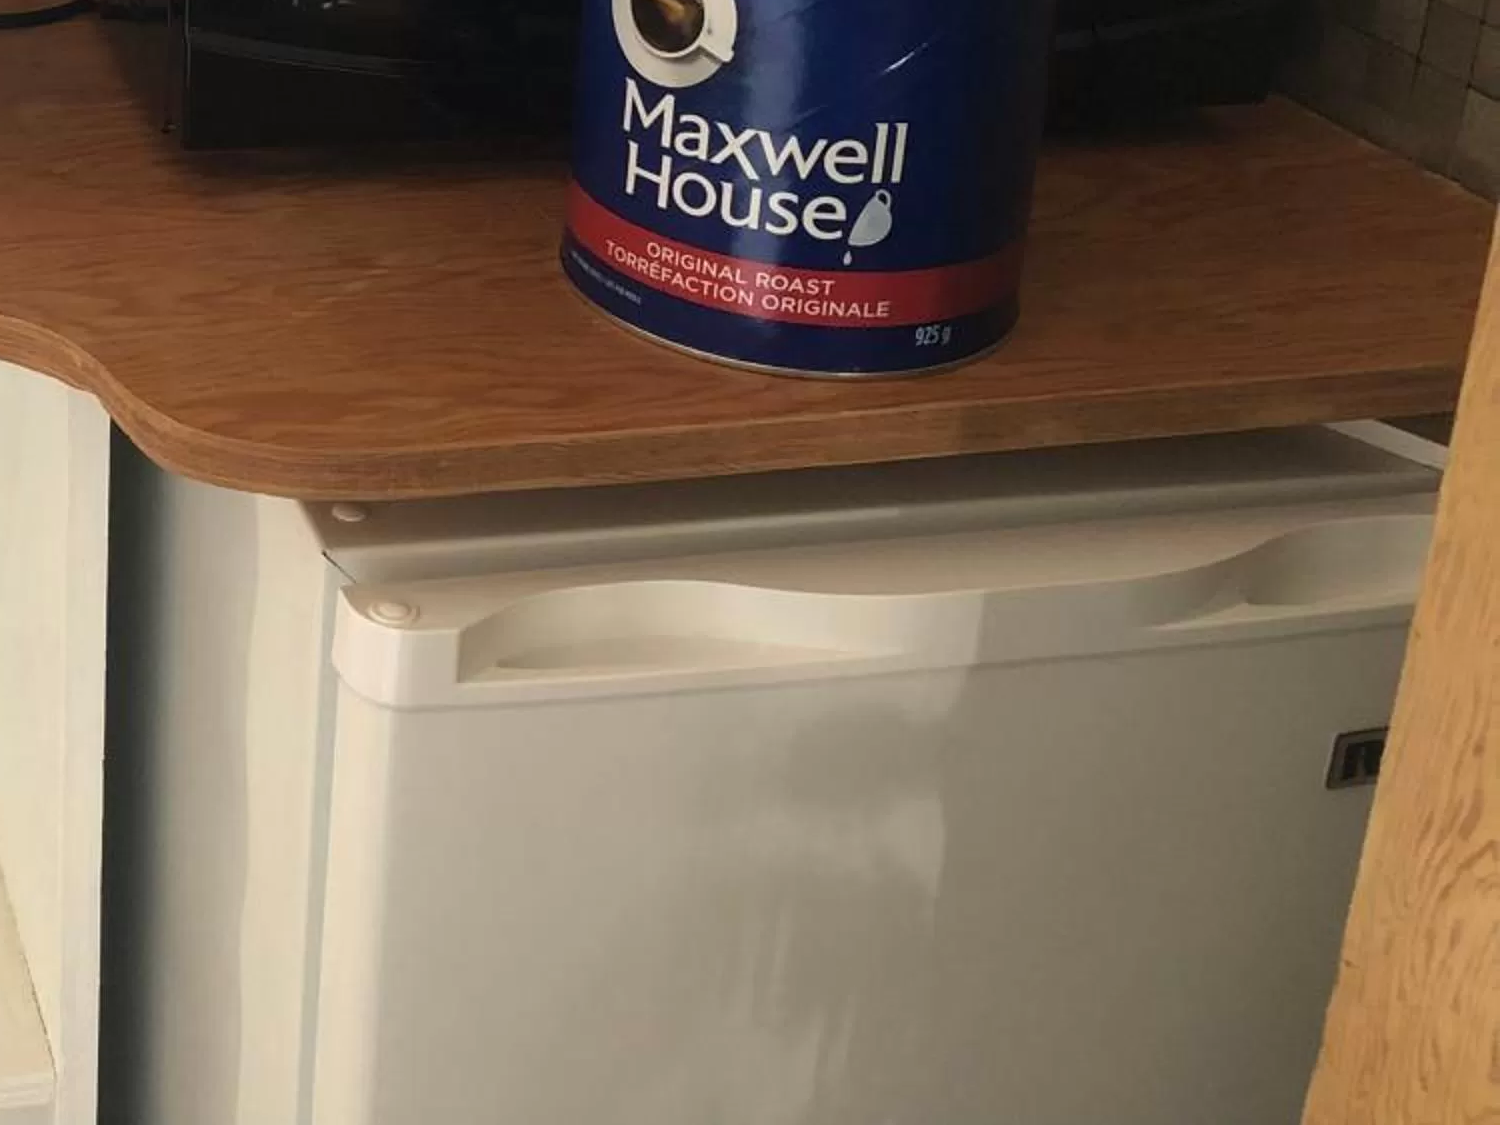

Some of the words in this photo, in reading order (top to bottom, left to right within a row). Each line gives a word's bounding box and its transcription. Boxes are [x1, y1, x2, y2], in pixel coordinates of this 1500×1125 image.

[622, 78, 909, 184] Maxwell
[625, 140, 847, 241] House
[605, 241, 754, 307] TORRÉFACTION
[761, 294, 891, 318] ORIGINALE
[646, 242, 748, 286] ORIGINAL
[755, 272, 835, 296] ROAST
[915, 326, 941, 347] 925
